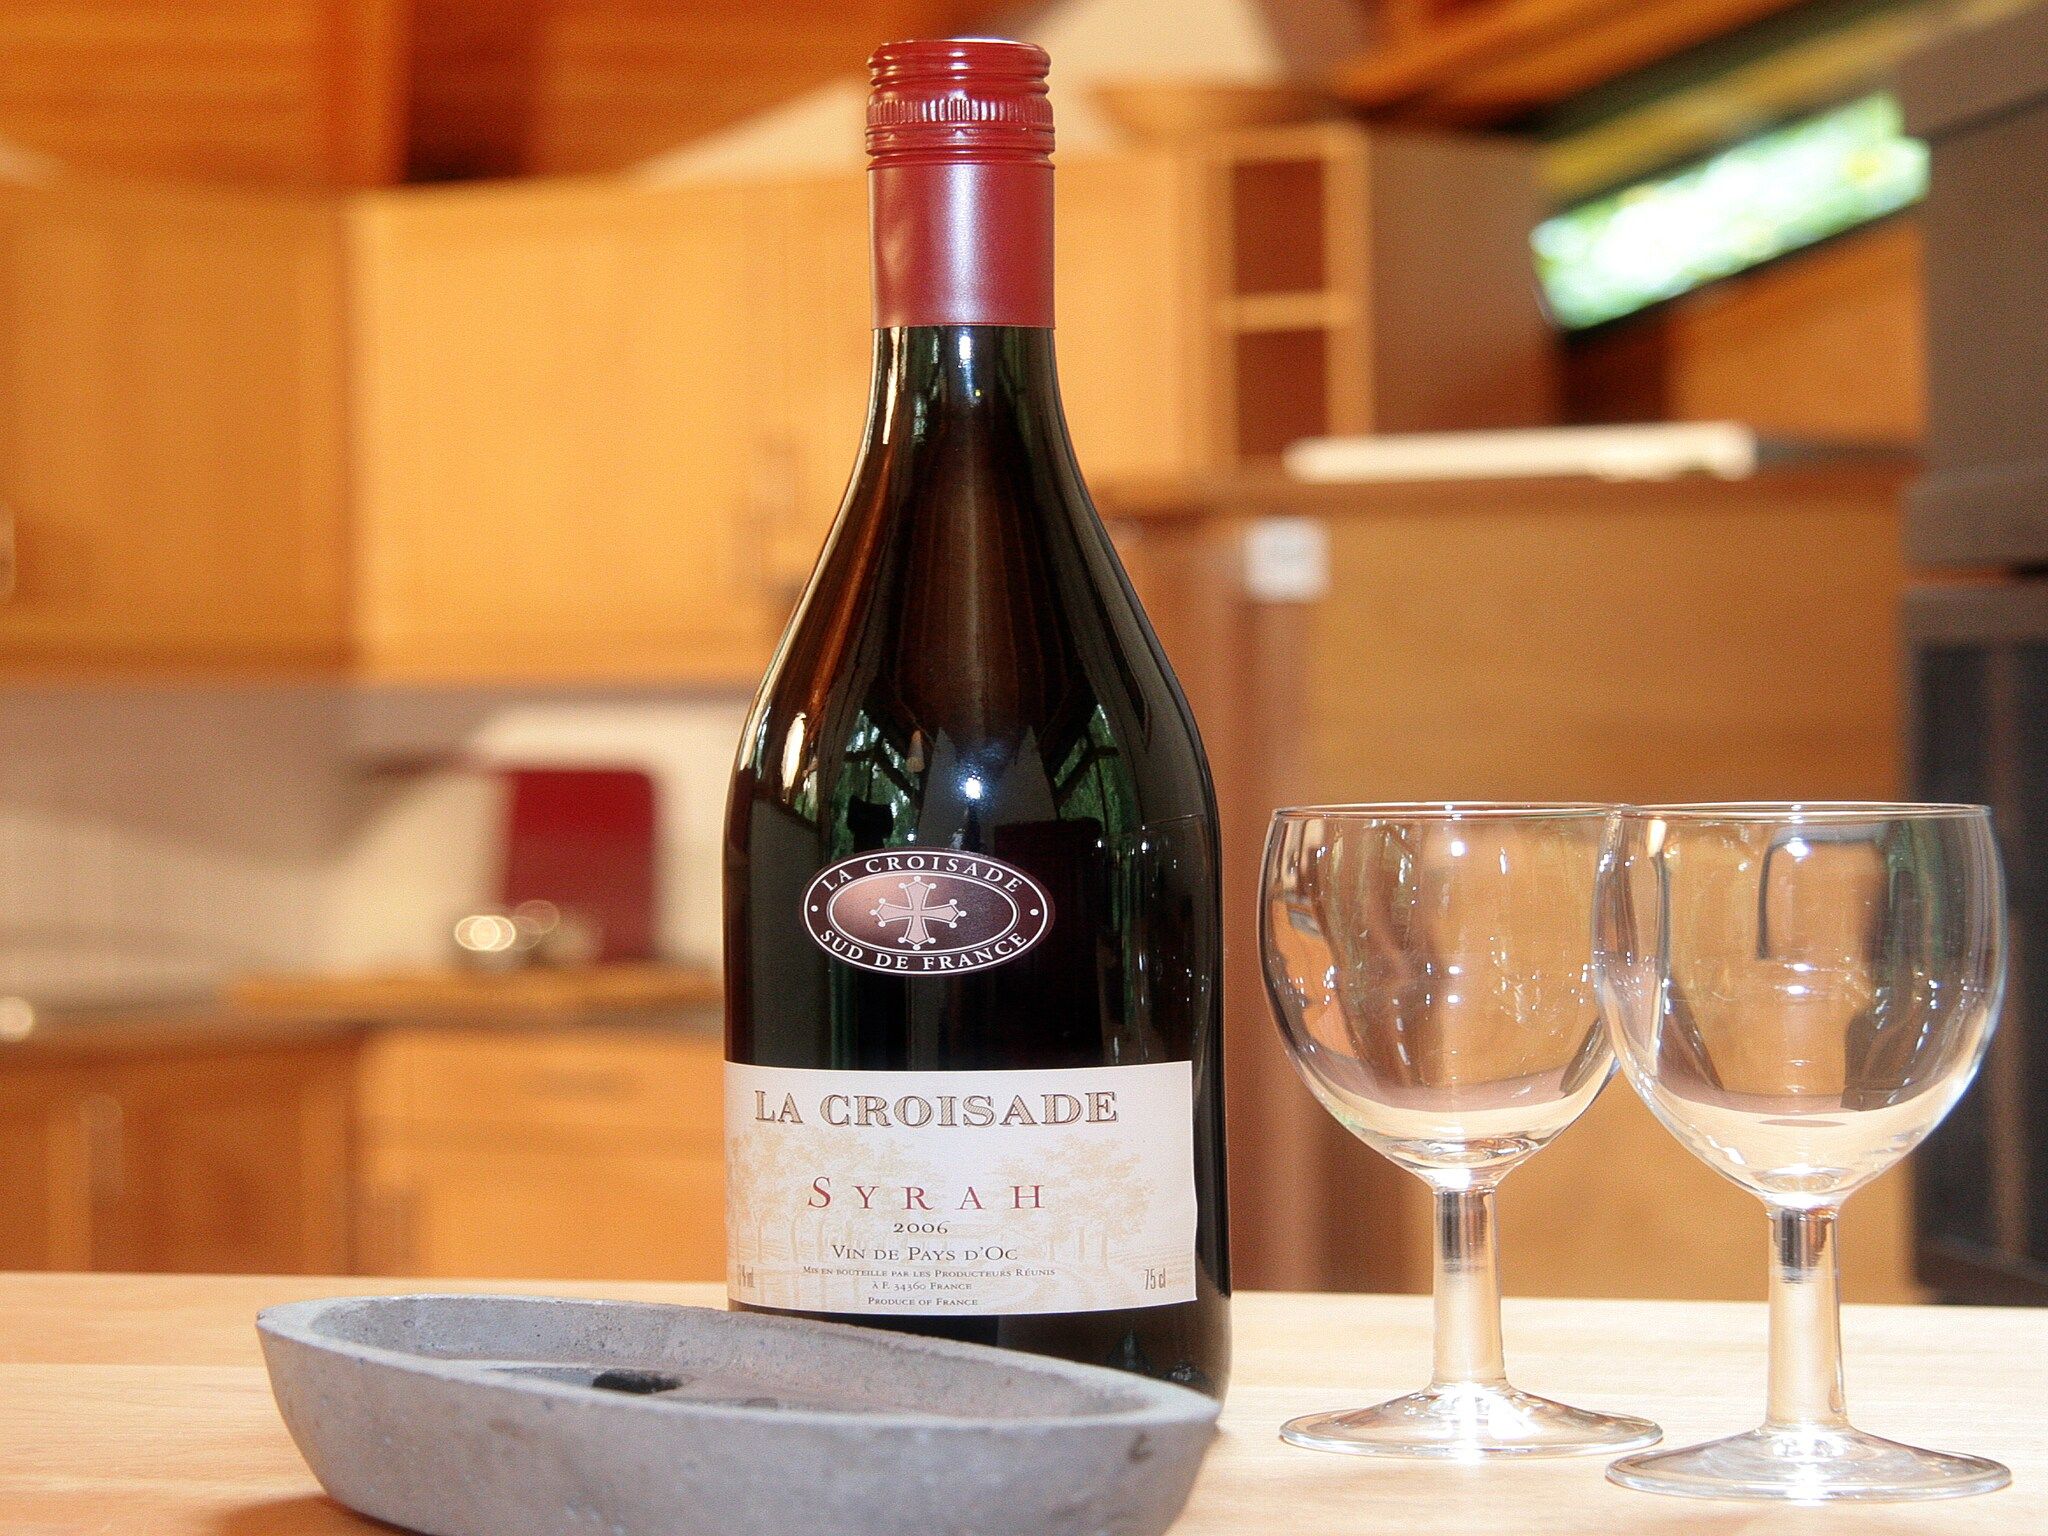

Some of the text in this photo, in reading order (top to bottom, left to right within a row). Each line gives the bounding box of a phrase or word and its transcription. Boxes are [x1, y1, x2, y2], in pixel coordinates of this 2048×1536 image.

[822, 855, 1024, 893] LA CROISADE
[819, 930, 1027, 970] SUD DE FRANCE
[755, 1089, 1119, 1128] LA CROISADE
[808, 1175, 1046, 1211] SYRAH
[893, 1221, 948, 1235] 2006
[832, 1244, 1019, 1261] VIN DE PAYS D'OC
[836, 1268, 888, 1277] BOUTEILLE
[891, 1270, 909, 1278] PAR
[913, 1270, 931, 1278] LES
[934, 1269, 1013, 1278] PRODUCTEURS
[1016, 1267, 1056, 1277] RÉUNIS
[1145, 1268, 1167, 1290] 75 cl
[930, 1282, 972, 1290] FRANCE
[867, 1297, 978, 1306] PRODUCE OF FRANCE
